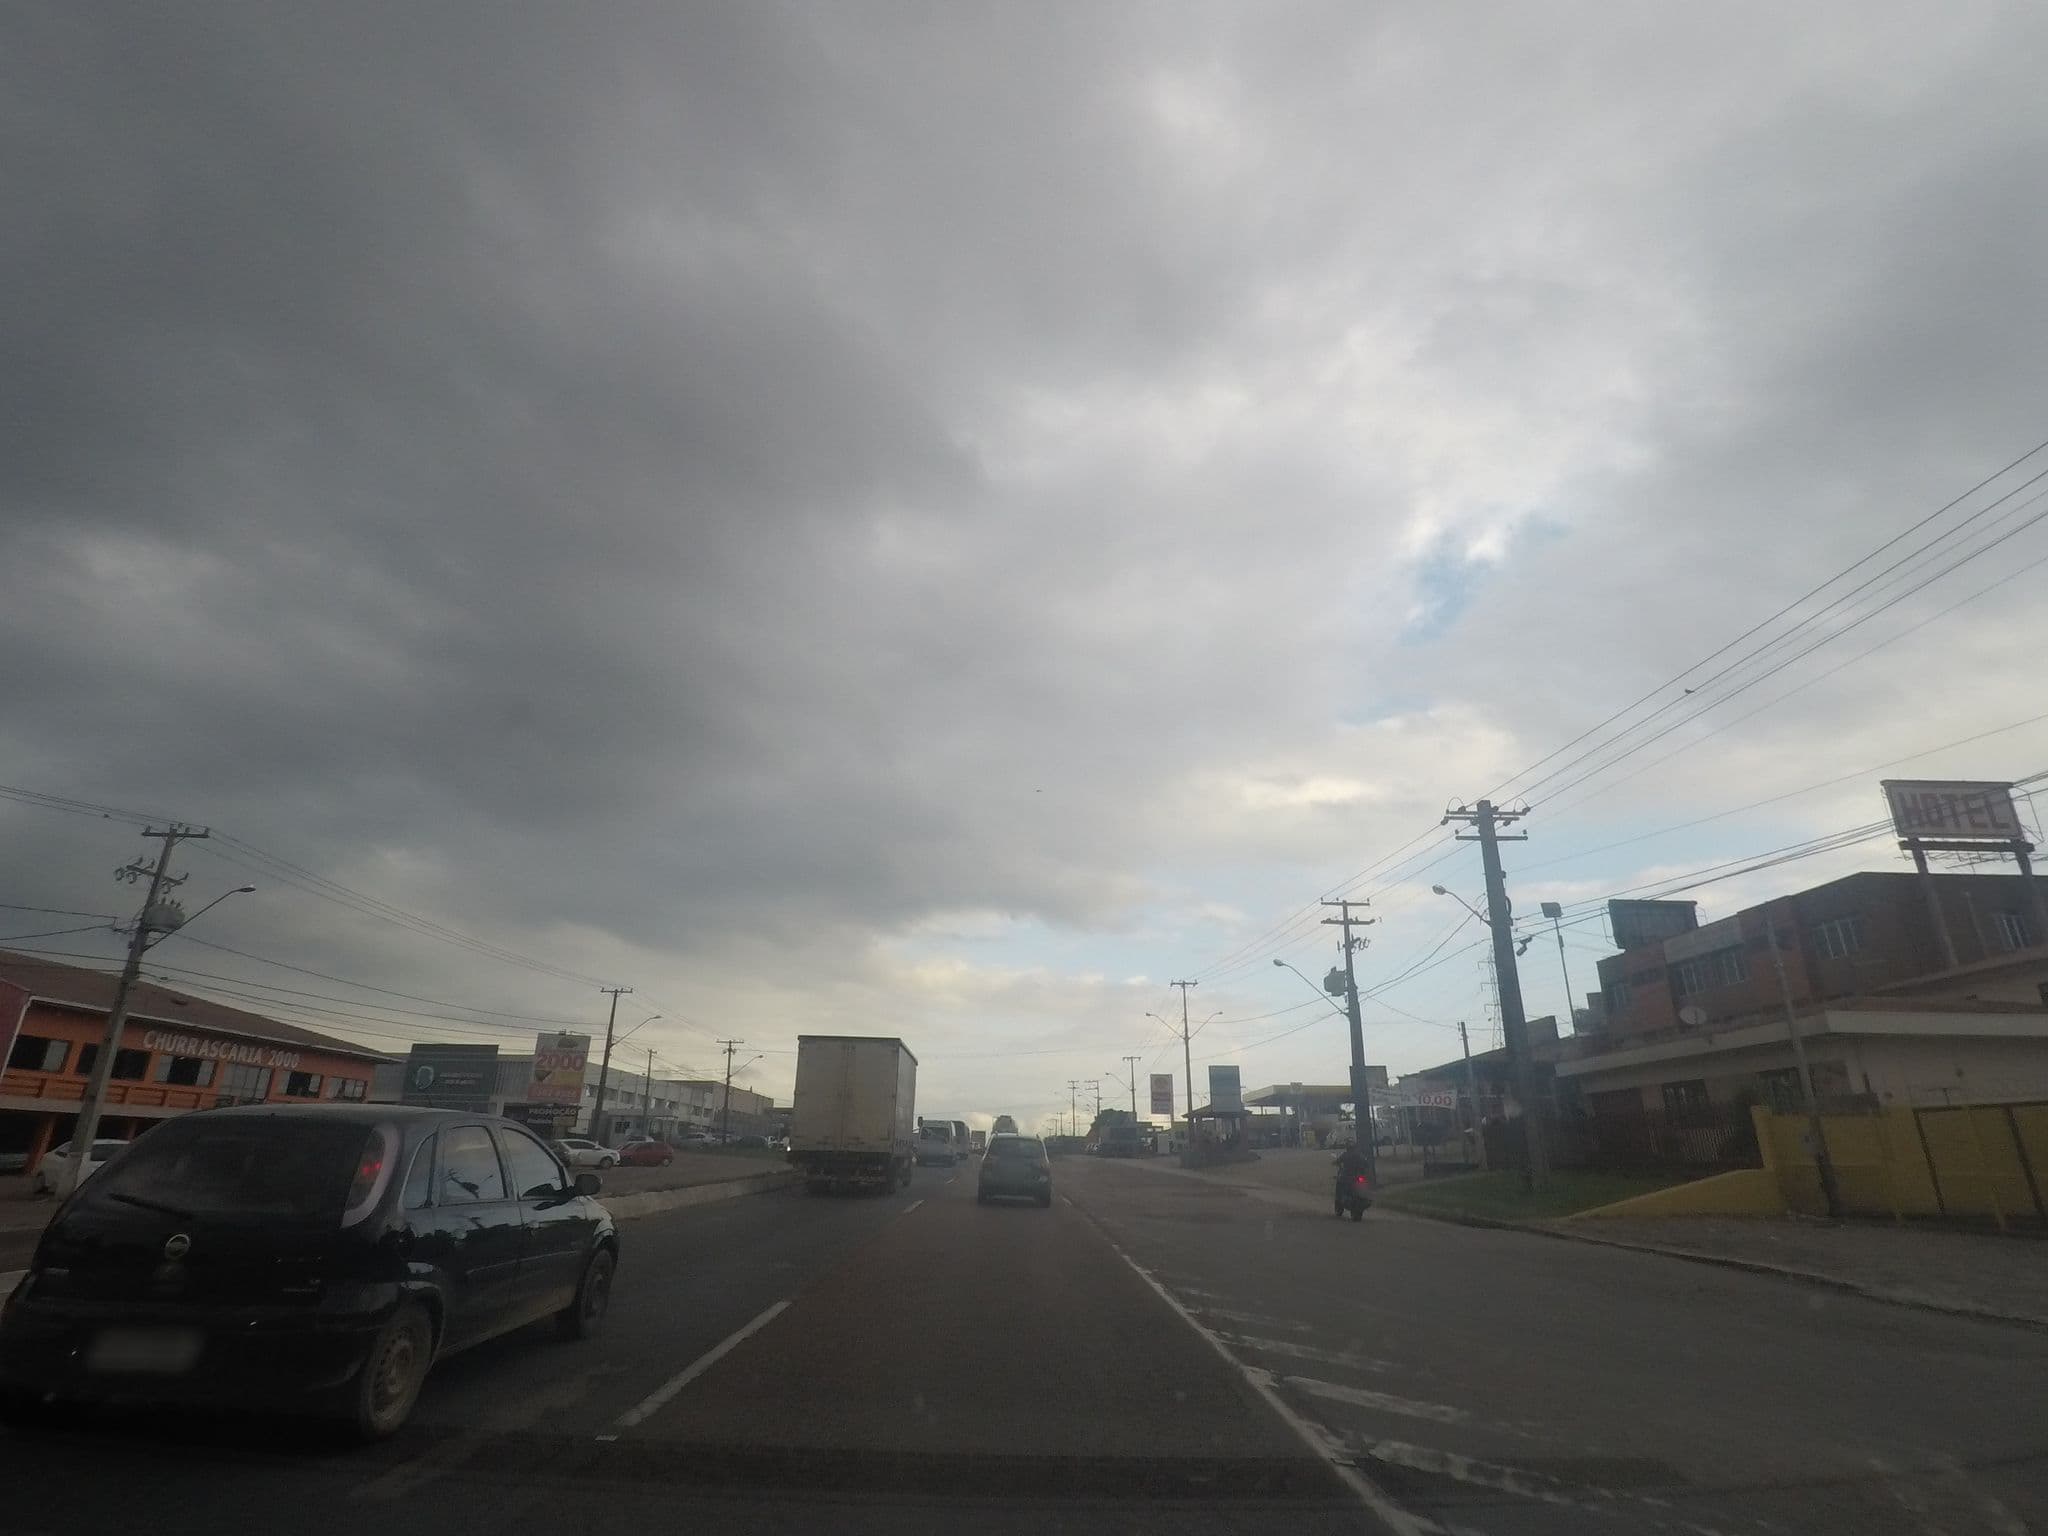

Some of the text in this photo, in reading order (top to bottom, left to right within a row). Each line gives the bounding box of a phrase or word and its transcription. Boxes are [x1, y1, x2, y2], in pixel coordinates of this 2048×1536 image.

[143, 1030, 300, 1069] CHURRASCARIA 2000
[535, 1055, 585, 1071] 2000
[1417, 1095, 1453, 1106] 10,00
